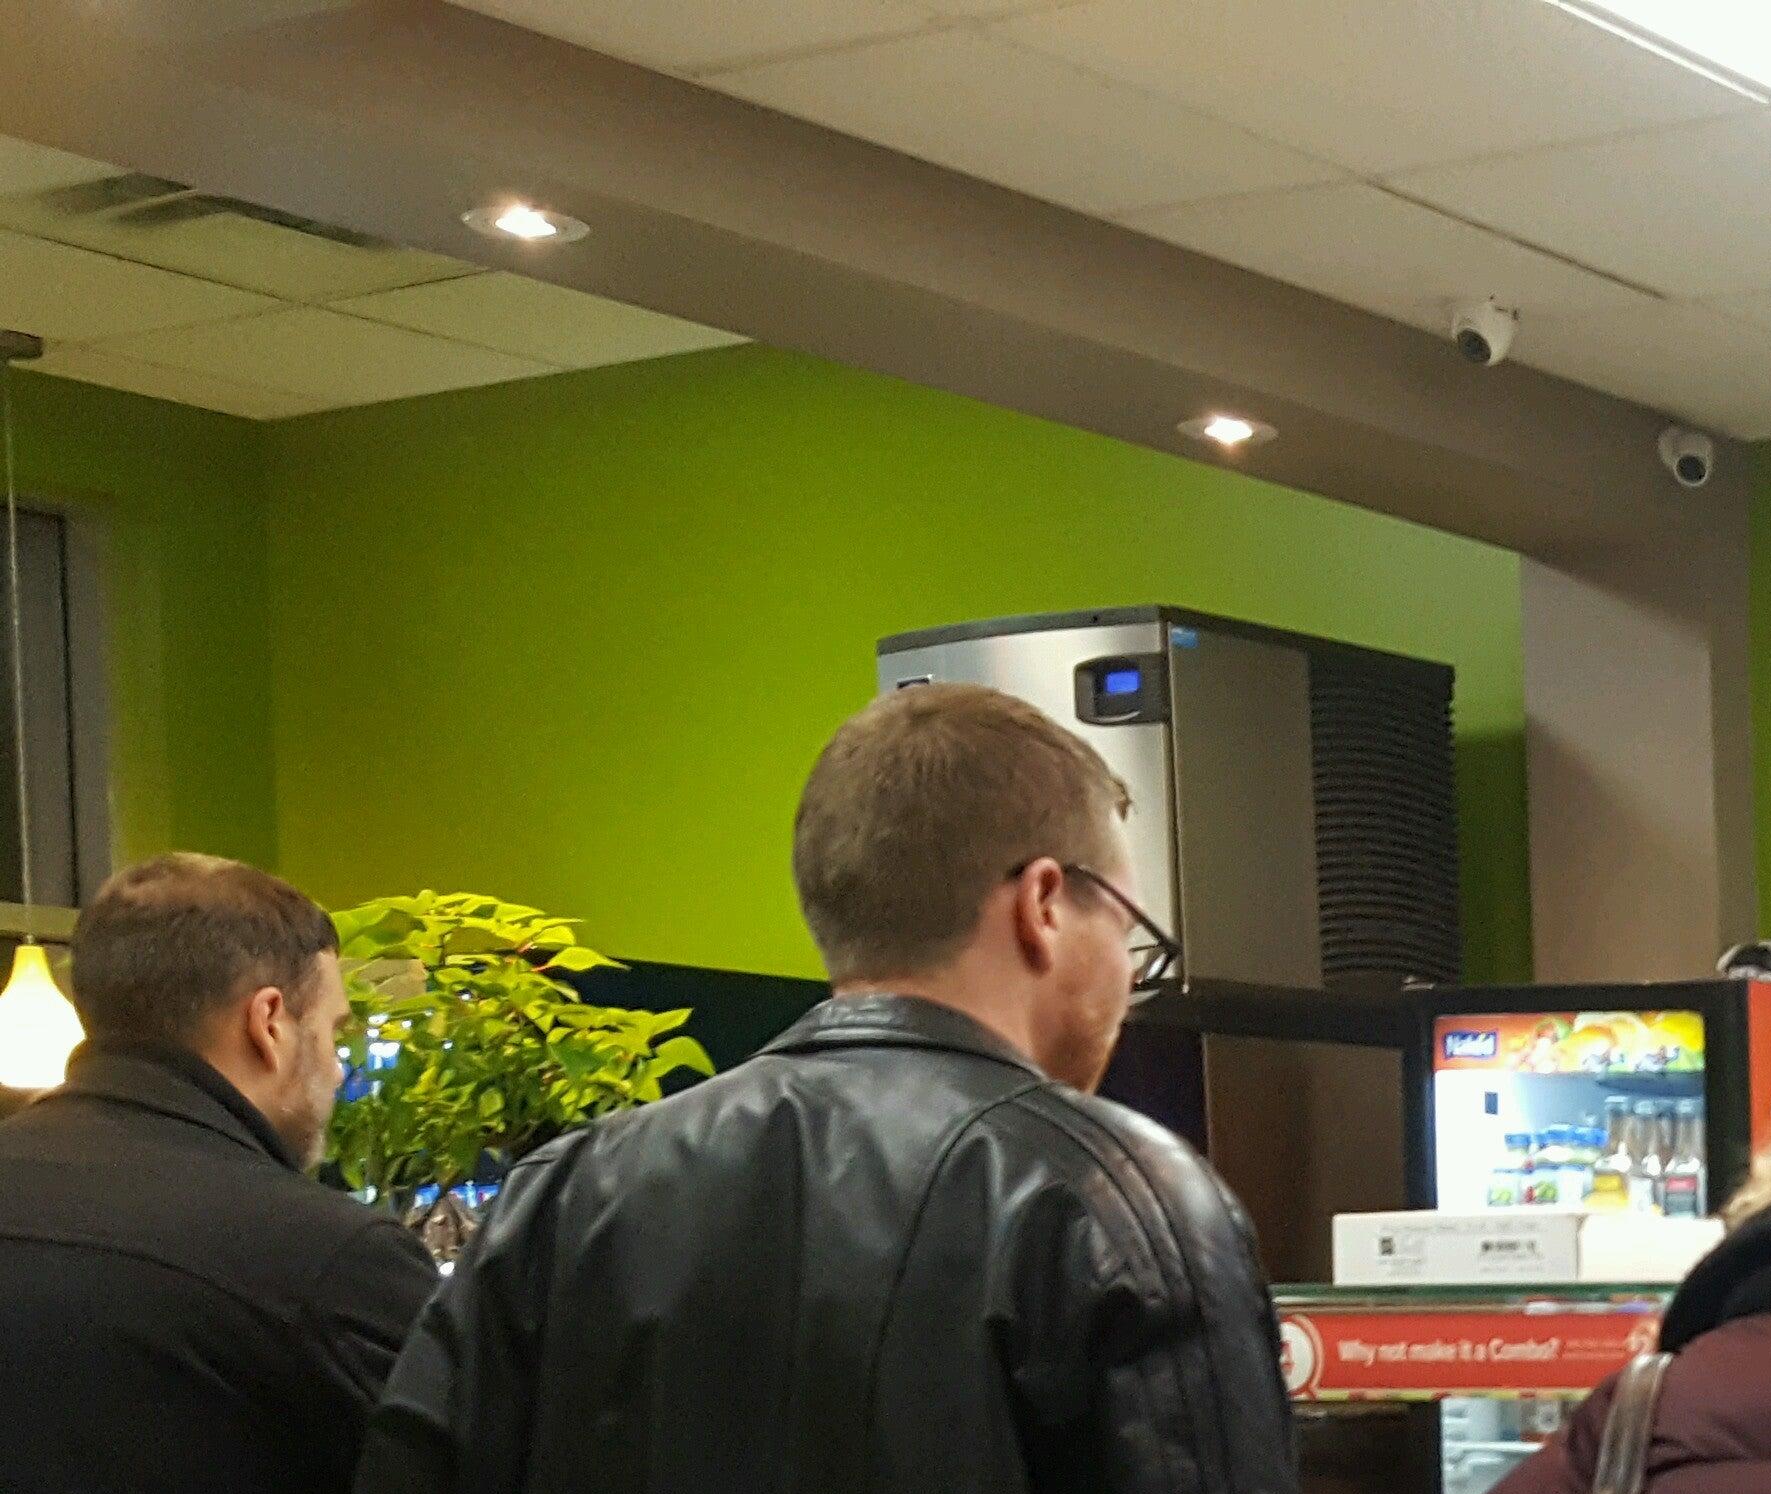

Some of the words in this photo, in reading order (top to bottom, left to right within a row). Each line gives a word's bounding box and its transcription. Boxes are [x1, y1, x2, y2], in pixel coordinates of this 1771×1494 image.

[1338, 1339, 1377, 1367] Why
[1378, 1342, 1408, 1362] not
[1409, 1339, 1456, 1362] make
[1458, 1339, 1473, 1362] it
[1474, 1343, 1488, 1362] a
